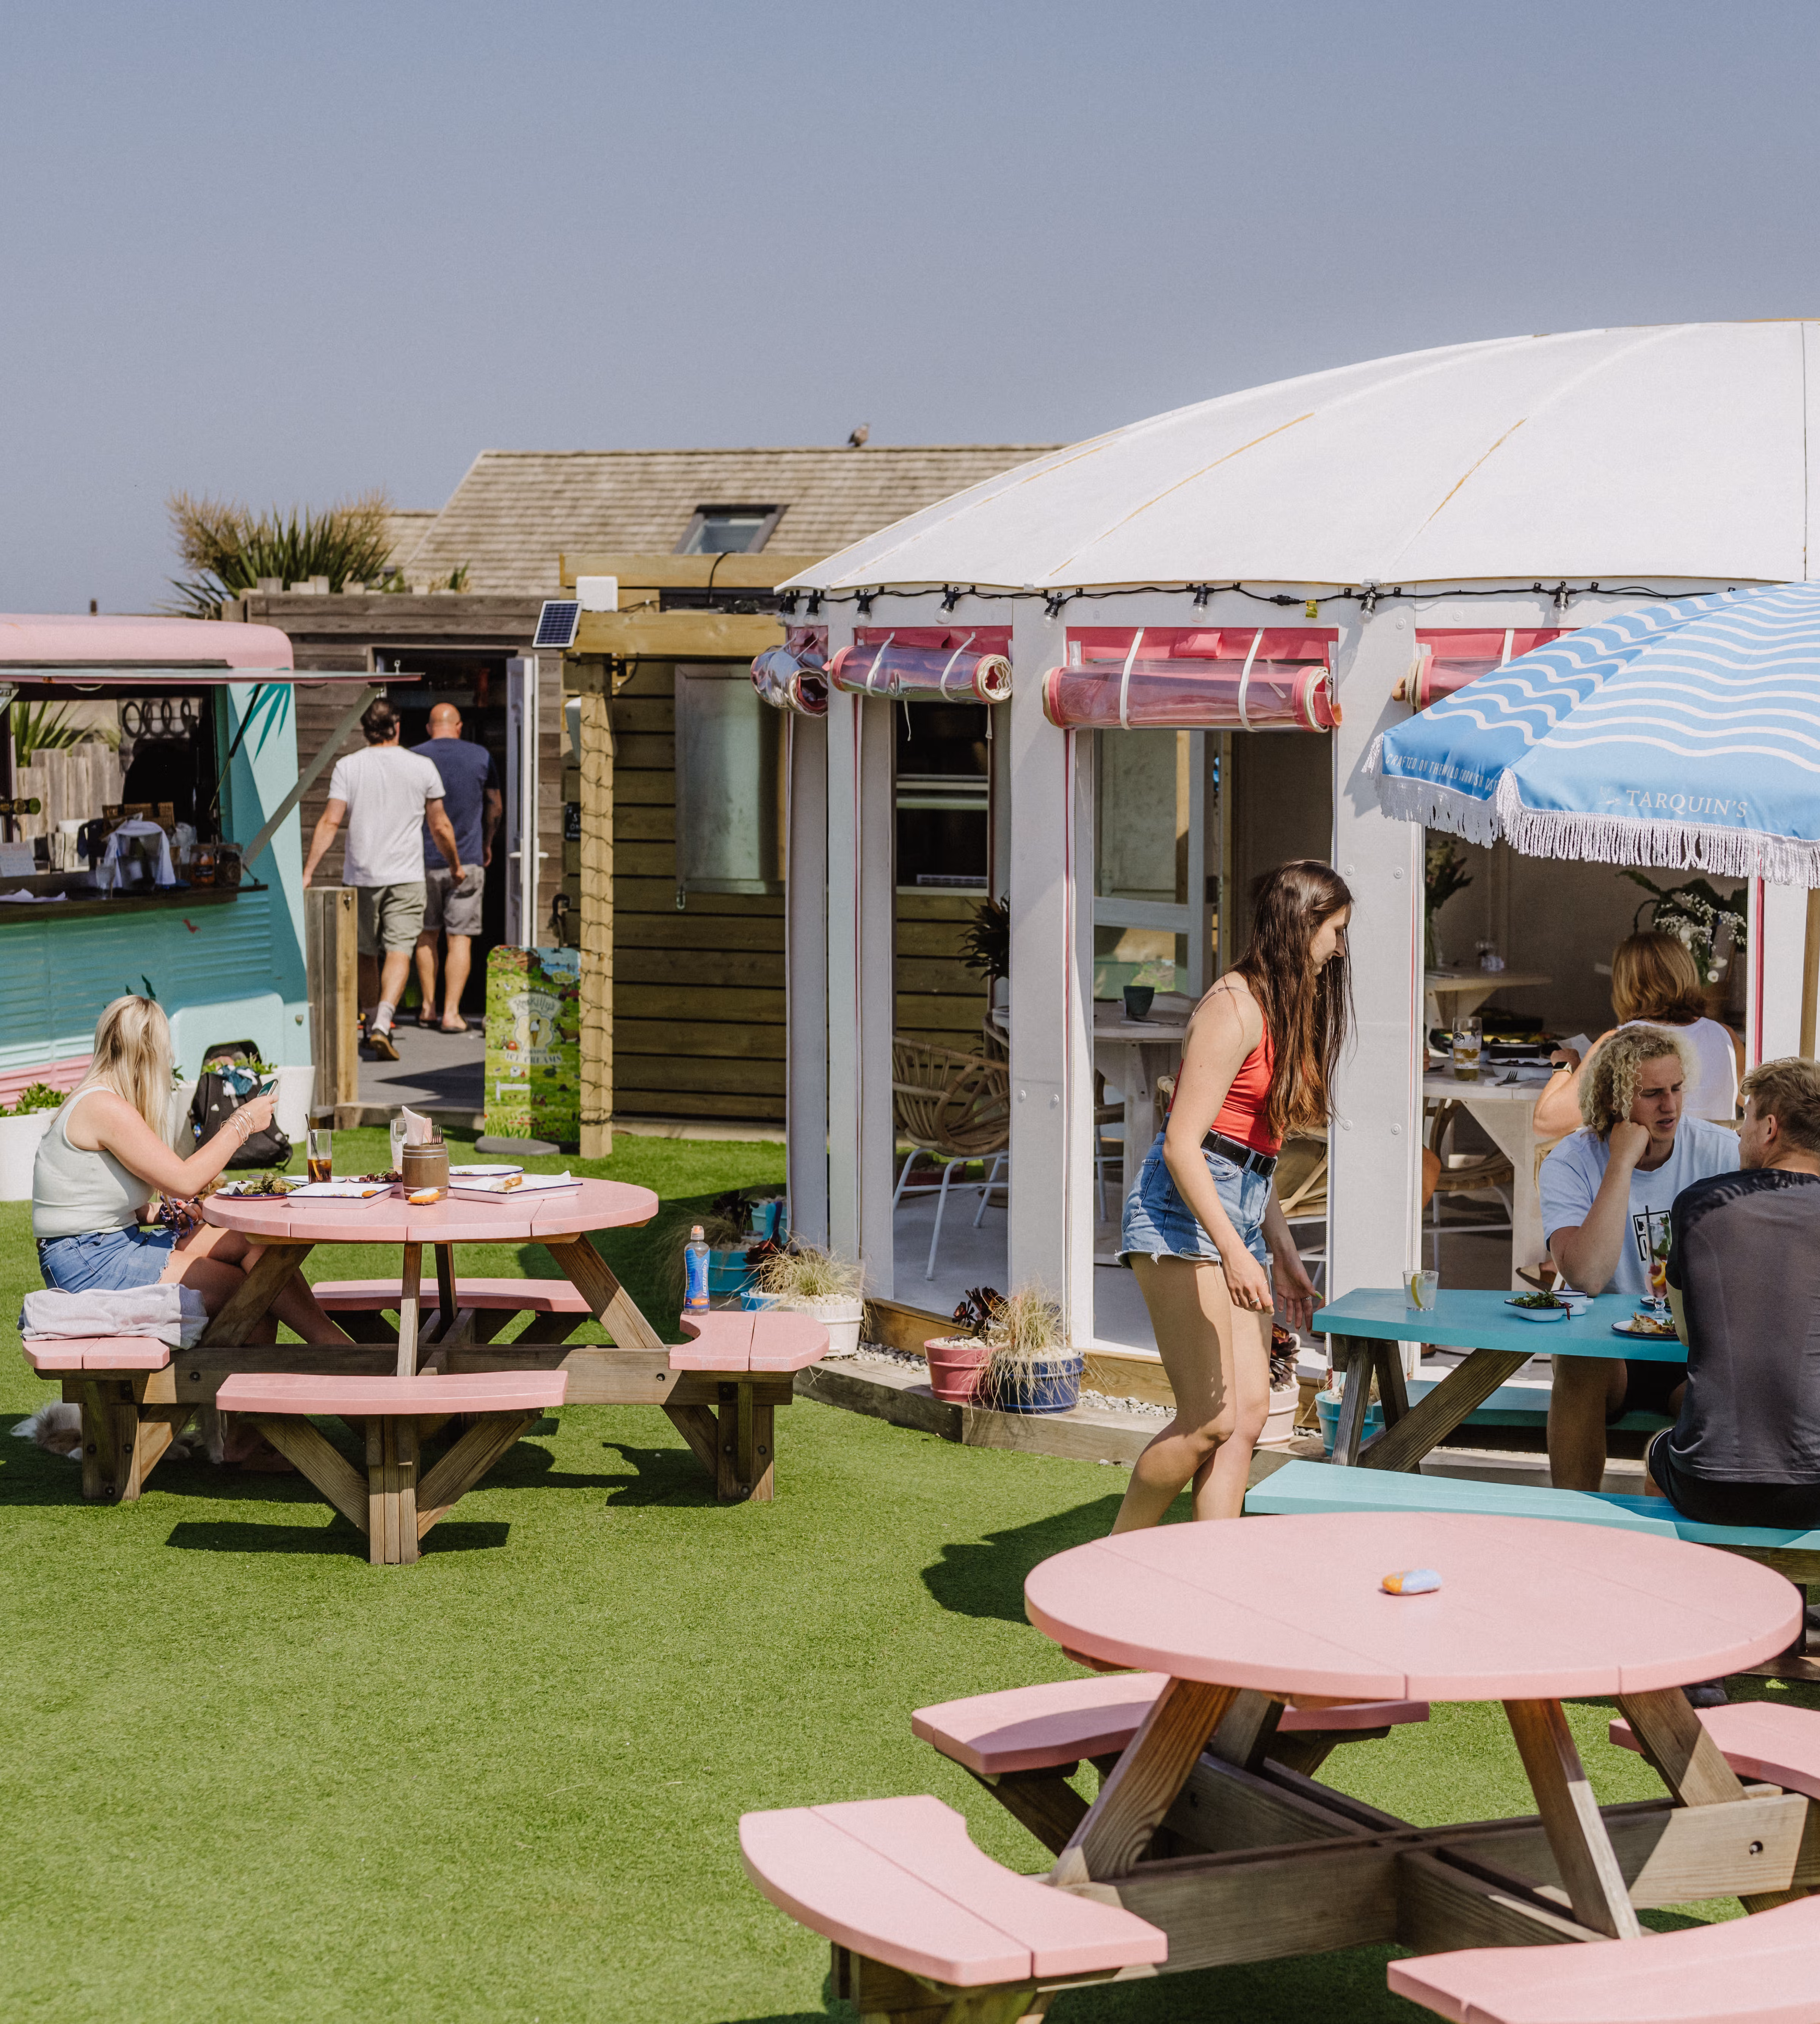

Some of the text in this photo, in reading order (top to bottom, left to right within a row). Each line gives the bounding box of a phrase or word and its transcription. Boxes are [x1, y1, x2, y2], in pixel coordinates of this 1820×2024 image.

[1385, 753, 1417, 769] CRAFTED
[1419, 759, 1428, 772] ON
[1458, 769, 1484, 787] CORNISH
[1626, 789, 1748, 818] TARQUIN'S
